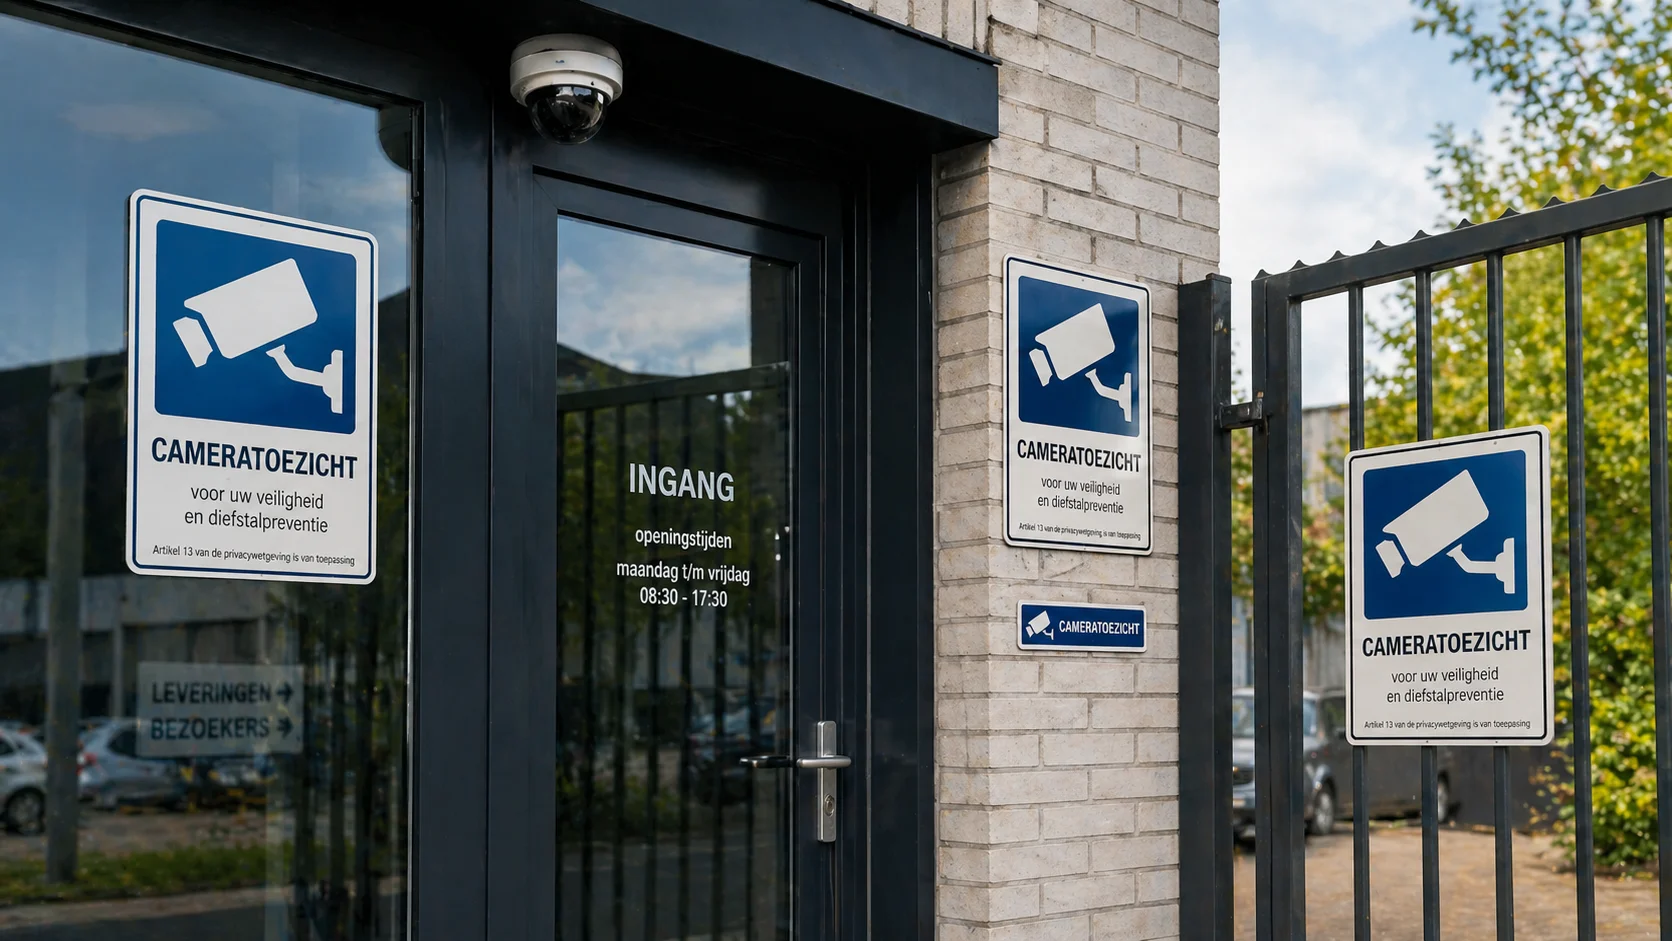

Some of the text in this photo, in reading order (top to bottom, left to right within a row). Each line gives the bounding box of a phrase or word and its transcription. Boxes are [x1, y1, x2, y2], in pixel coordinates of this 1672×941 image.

[152, 437, 358, 479] CAMERATOEZICHT
[1017, 439, 1141, 472] CAMERATOEZICHT
[629, 463, 734, 502] INGANG
[1041, 477, 1121, 496] voor uw veiligheid
[191, 486, 324, 511] voor uw veiligheid
[1038, 495, 1124, 514] en diefstalpreventie
[184, 509, 328, 533] en diefstalpreventie
[635, 528, 732, 551] openingstijden
[153, 544, 180, 556] Artikel
[183, 546, 193, 556] 13
[195, 549, 210, 557] van
[212, 548, 222, 558] de
[224, 549, 291, 564] privacywetgeving
[293, 552, 299, 562] is
[316, 555, 355, 568] toepassing
[616, 560, 750, 586] maandag t/m vrijdag
[640, 587, 678, 605] 08:30
[692, 589, 728, 607] 17:30
[1058, 620, 1140, 635] CAMERATOEZICHT
[1362, 629, 1531, 657] CAMERATOEZICHT
[1391, 666, 1499, 685] voor uw veiligheid
[152, 682, 272, 704] LEVERINGEN
[1386, 687, 1504, 704] en diefstalpreventie
[150, 717, 270, 740] BEZOEKERS
[1386, 720, 1394, 728] 13
[1406, 720, 1415, 728] de
[1473, 720, 1478, 728] is
